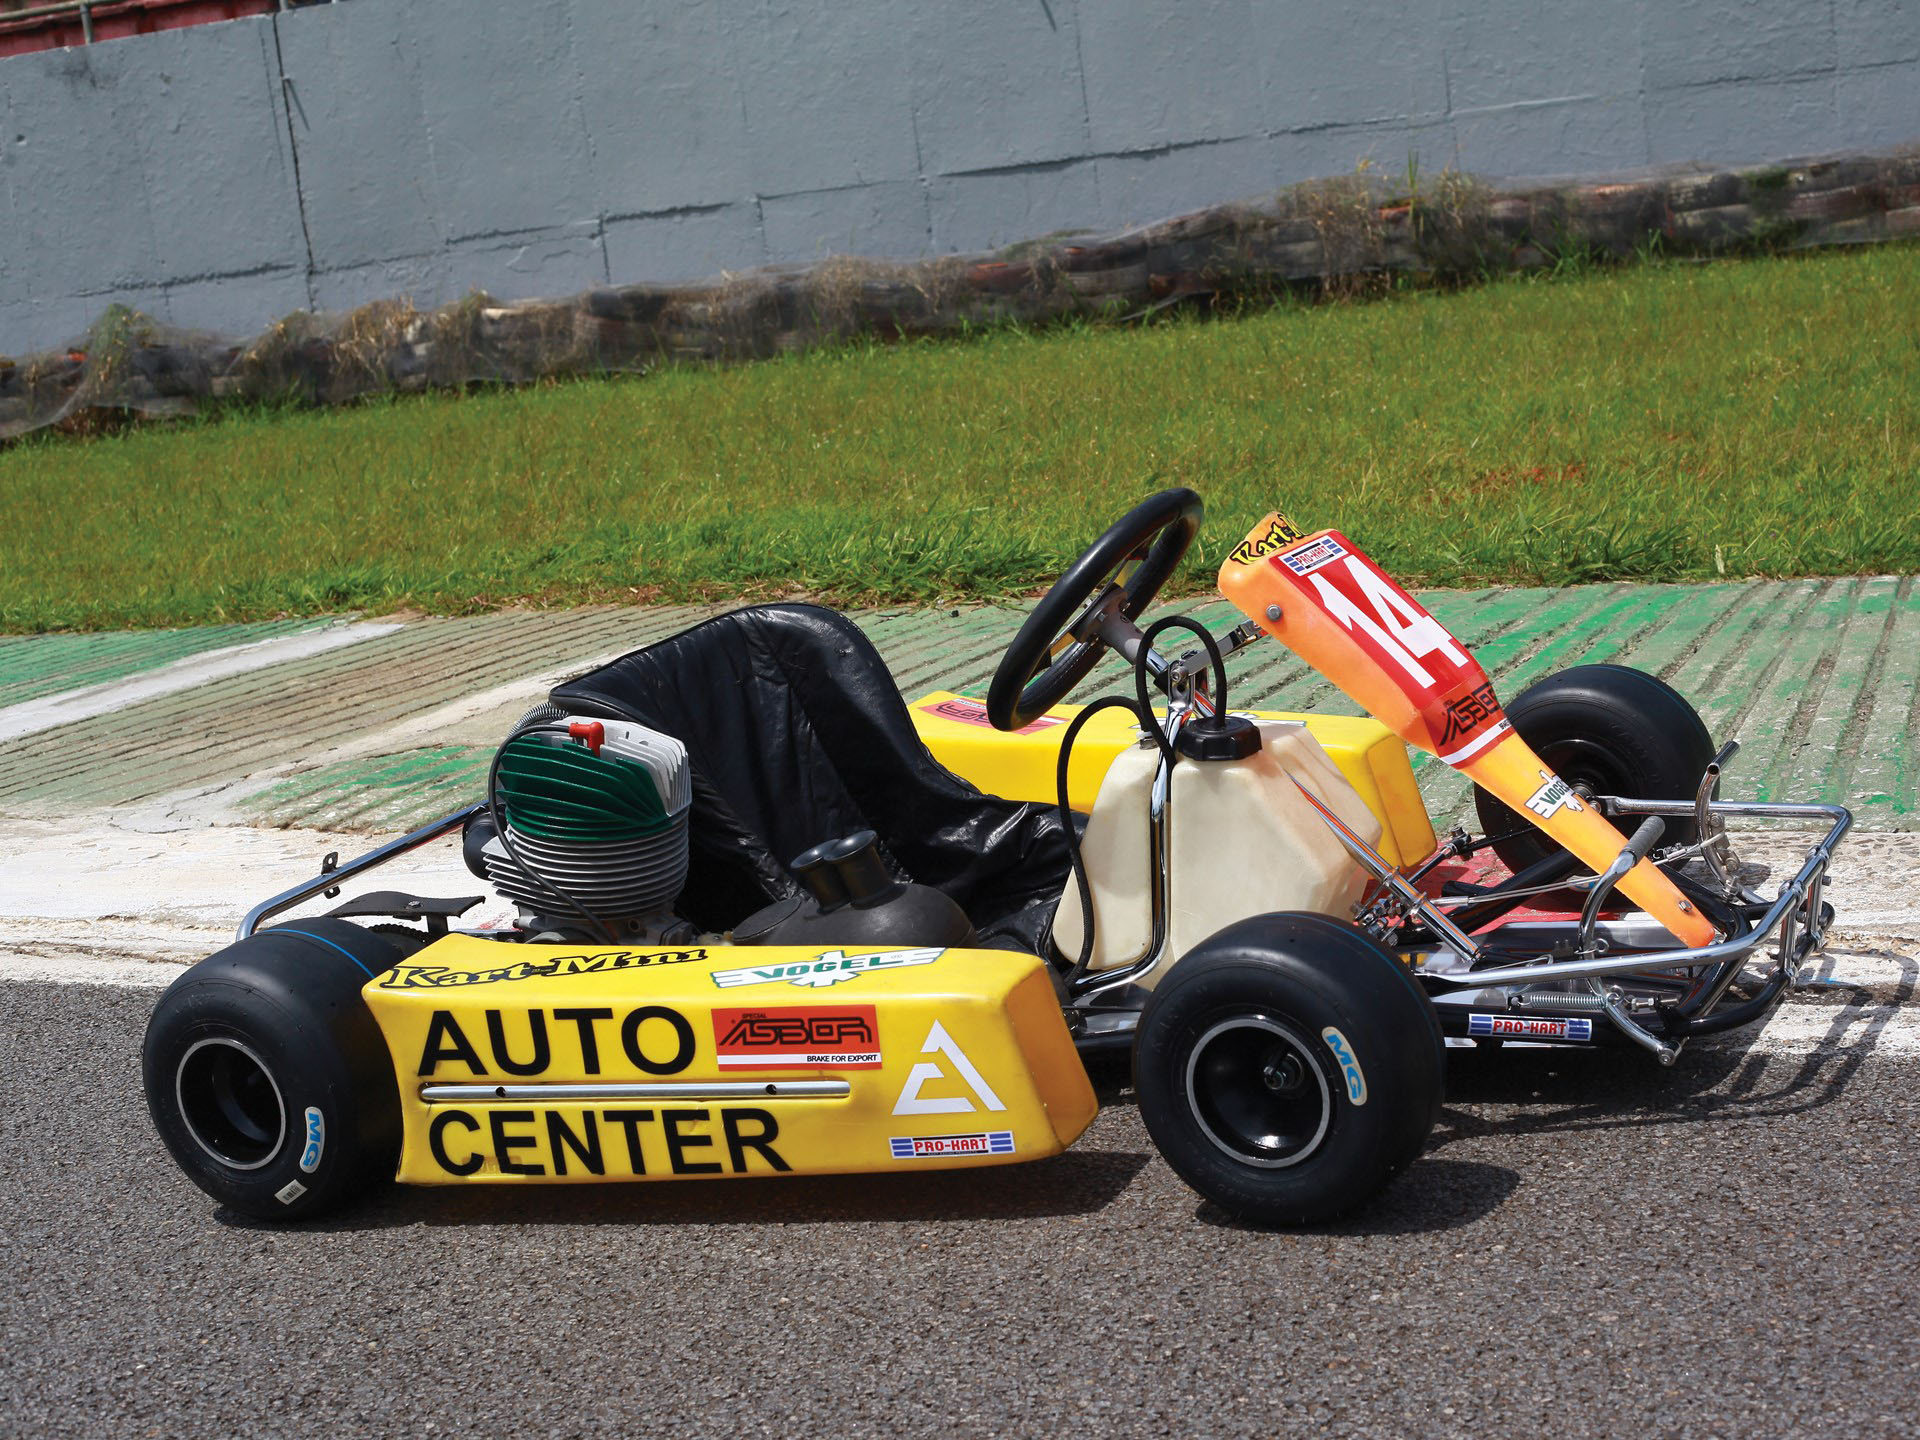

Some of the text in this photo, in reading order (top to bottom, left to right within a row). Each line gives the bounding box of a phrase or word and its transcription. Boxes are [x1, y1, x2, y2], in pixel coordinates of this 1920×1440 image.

[1307, 554, 1469, 689] 14
[752, 956, 904, 979] VOGEL
[417, 1005, 697, 1076] AUTO
[719, 1016, 873, 1047] ASBER
[847, 1054, 877, 1062] EXPORT
[1327, 1034, 1362, 1099] MG
[303, 1112, 321, 1167] MG
[429, 1107, 794, 1177] CENTER
